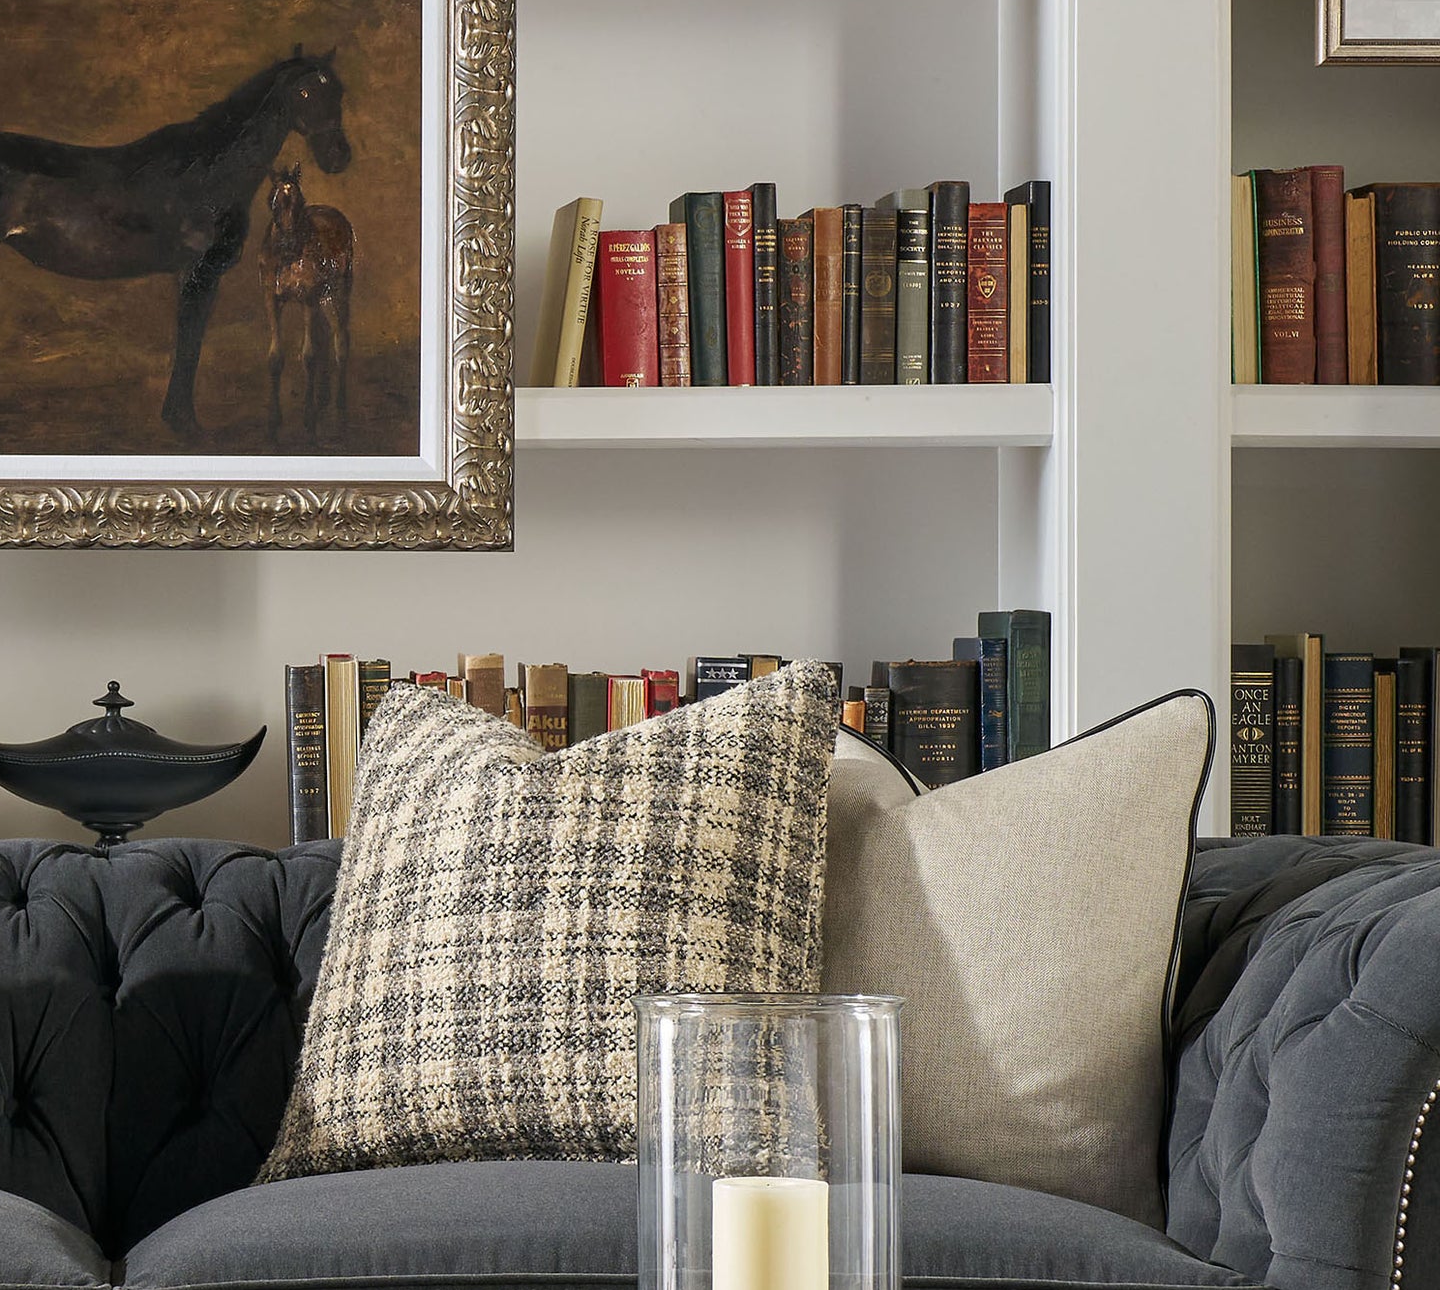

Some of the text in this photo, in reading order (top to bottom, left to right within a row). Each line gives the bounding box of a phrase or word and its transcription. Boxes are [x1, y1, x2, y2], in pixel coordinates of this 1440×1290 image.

[1394, 229, 1421, 237] PUBLIC
[590, 227, 600, 253] ROSE
[900, 245, 926, 253] SOCIETY
[586, 257, 596, 274] FOR
[614, 268, 645, 276] NOVELAS
[576, 276, 592, 326] VIRTUE
[1233, 687, 1269, 701] ONCE
[1241, 701, 1262, 713] AN
[1232, 713, 1272, 726] EAGLE
[1231, 742, 1273, 754] ANTON
[1232, 754, 1271, 764] MYRER
[1240, 815, 1261, 823] HOLT
